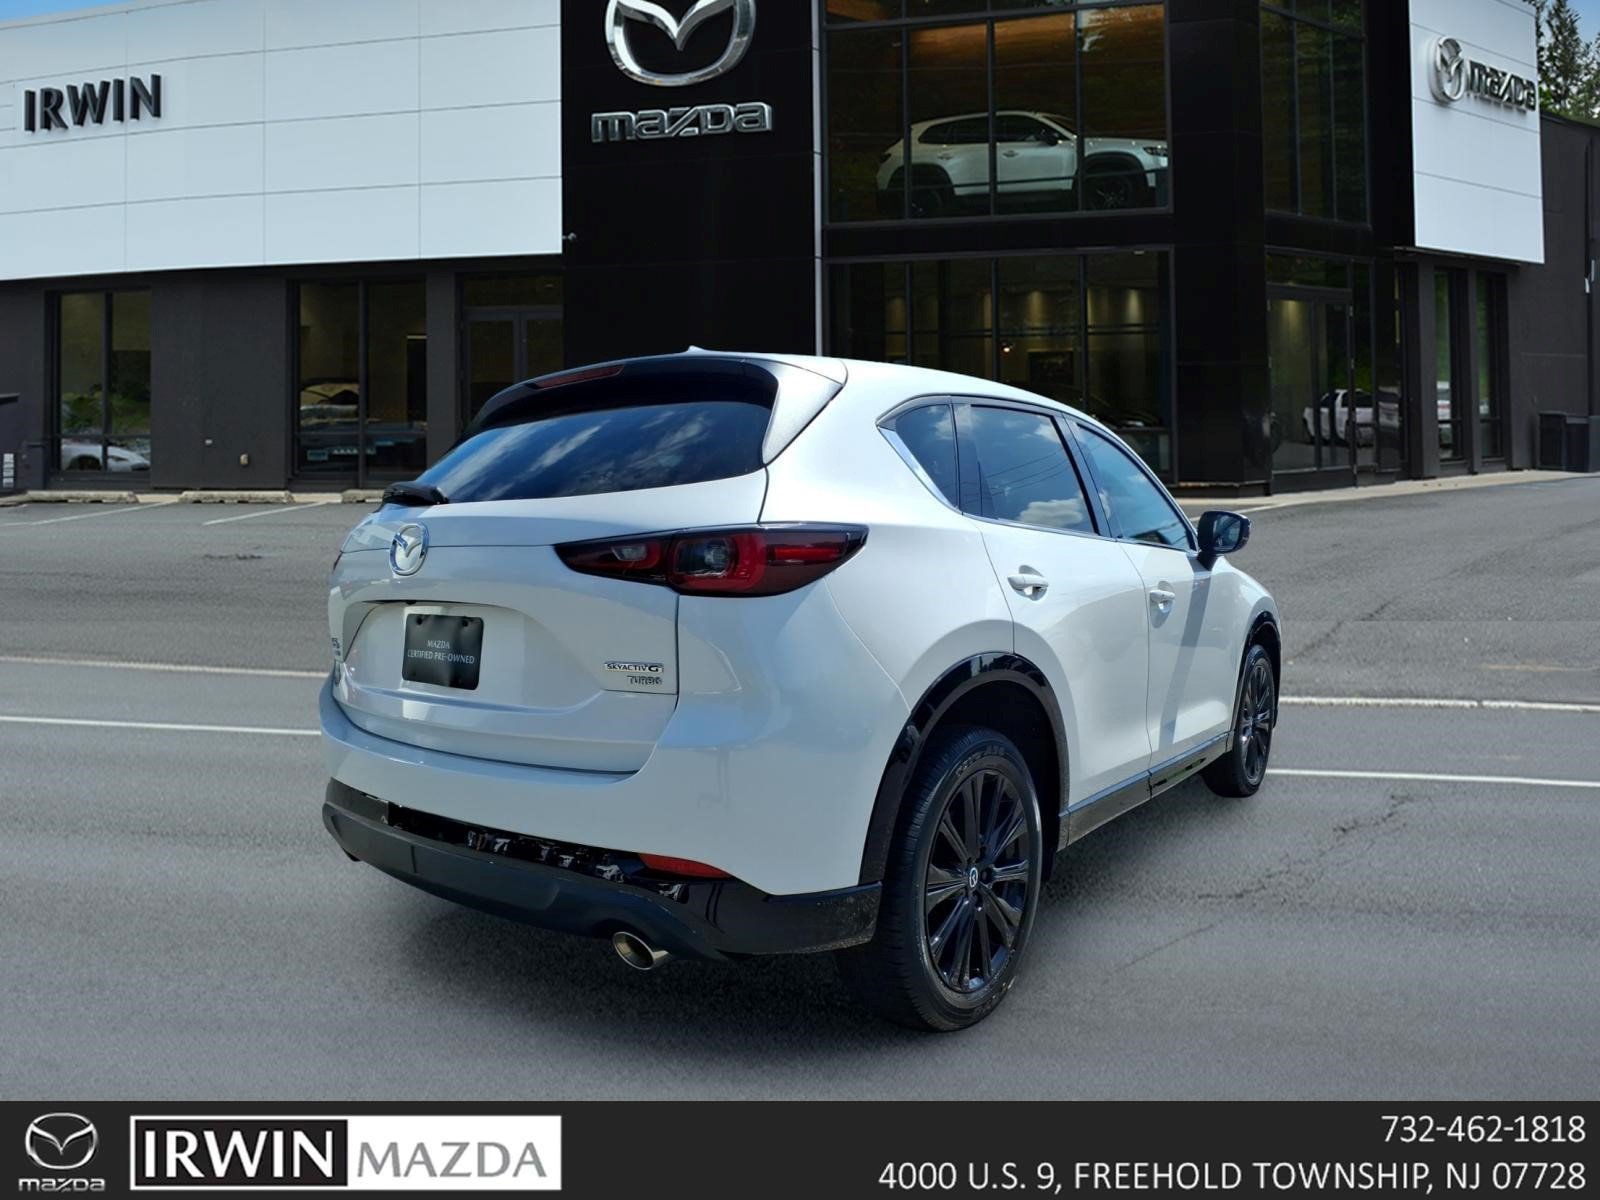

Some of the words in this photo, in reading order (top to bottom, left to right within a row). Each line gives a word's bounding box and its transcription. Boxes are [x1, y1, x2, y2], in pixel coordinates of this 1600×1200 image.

[24, 73, 162, 132] IRWIN
[426, 640, 450, 649] MAZDA
[407, 649, 433, 660] CERTIFIED
[434, 652, 475, 664] PRE-OWNED
